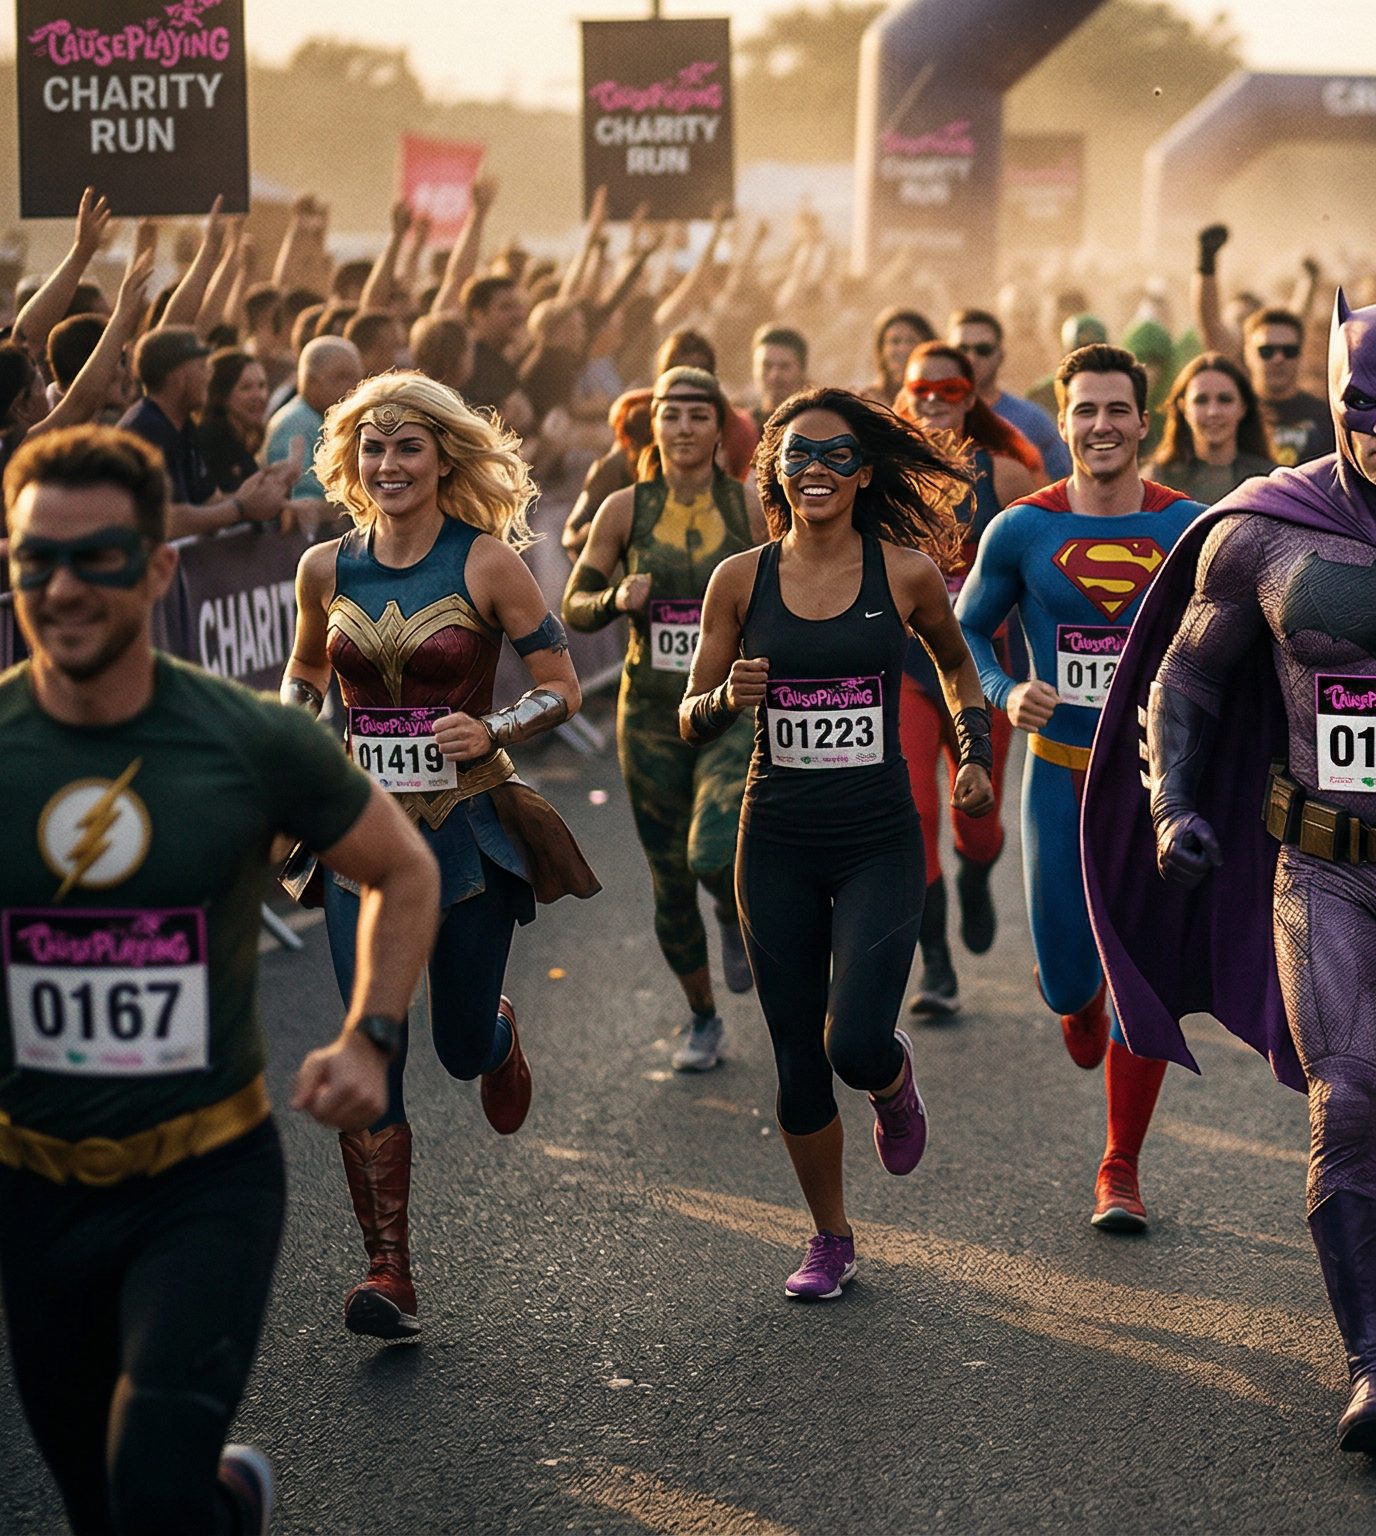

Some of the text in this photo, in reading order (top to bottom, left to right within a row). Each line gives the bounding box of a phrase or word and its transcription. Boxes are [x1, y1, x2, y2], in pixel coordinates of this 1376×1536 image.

[43, 73, 223, 112] CHARITY
[91, 116, 175, 154] RUN
[594, 115, 721, 146] CHARITY
[626, 147, 690, 175] RUN
[199, 580, 297, 677] CHARIT
[776, 715, 875, 749] 01223
[359, 743, 444, 774] 01419
[32, 979, 182, 1041] 0167
